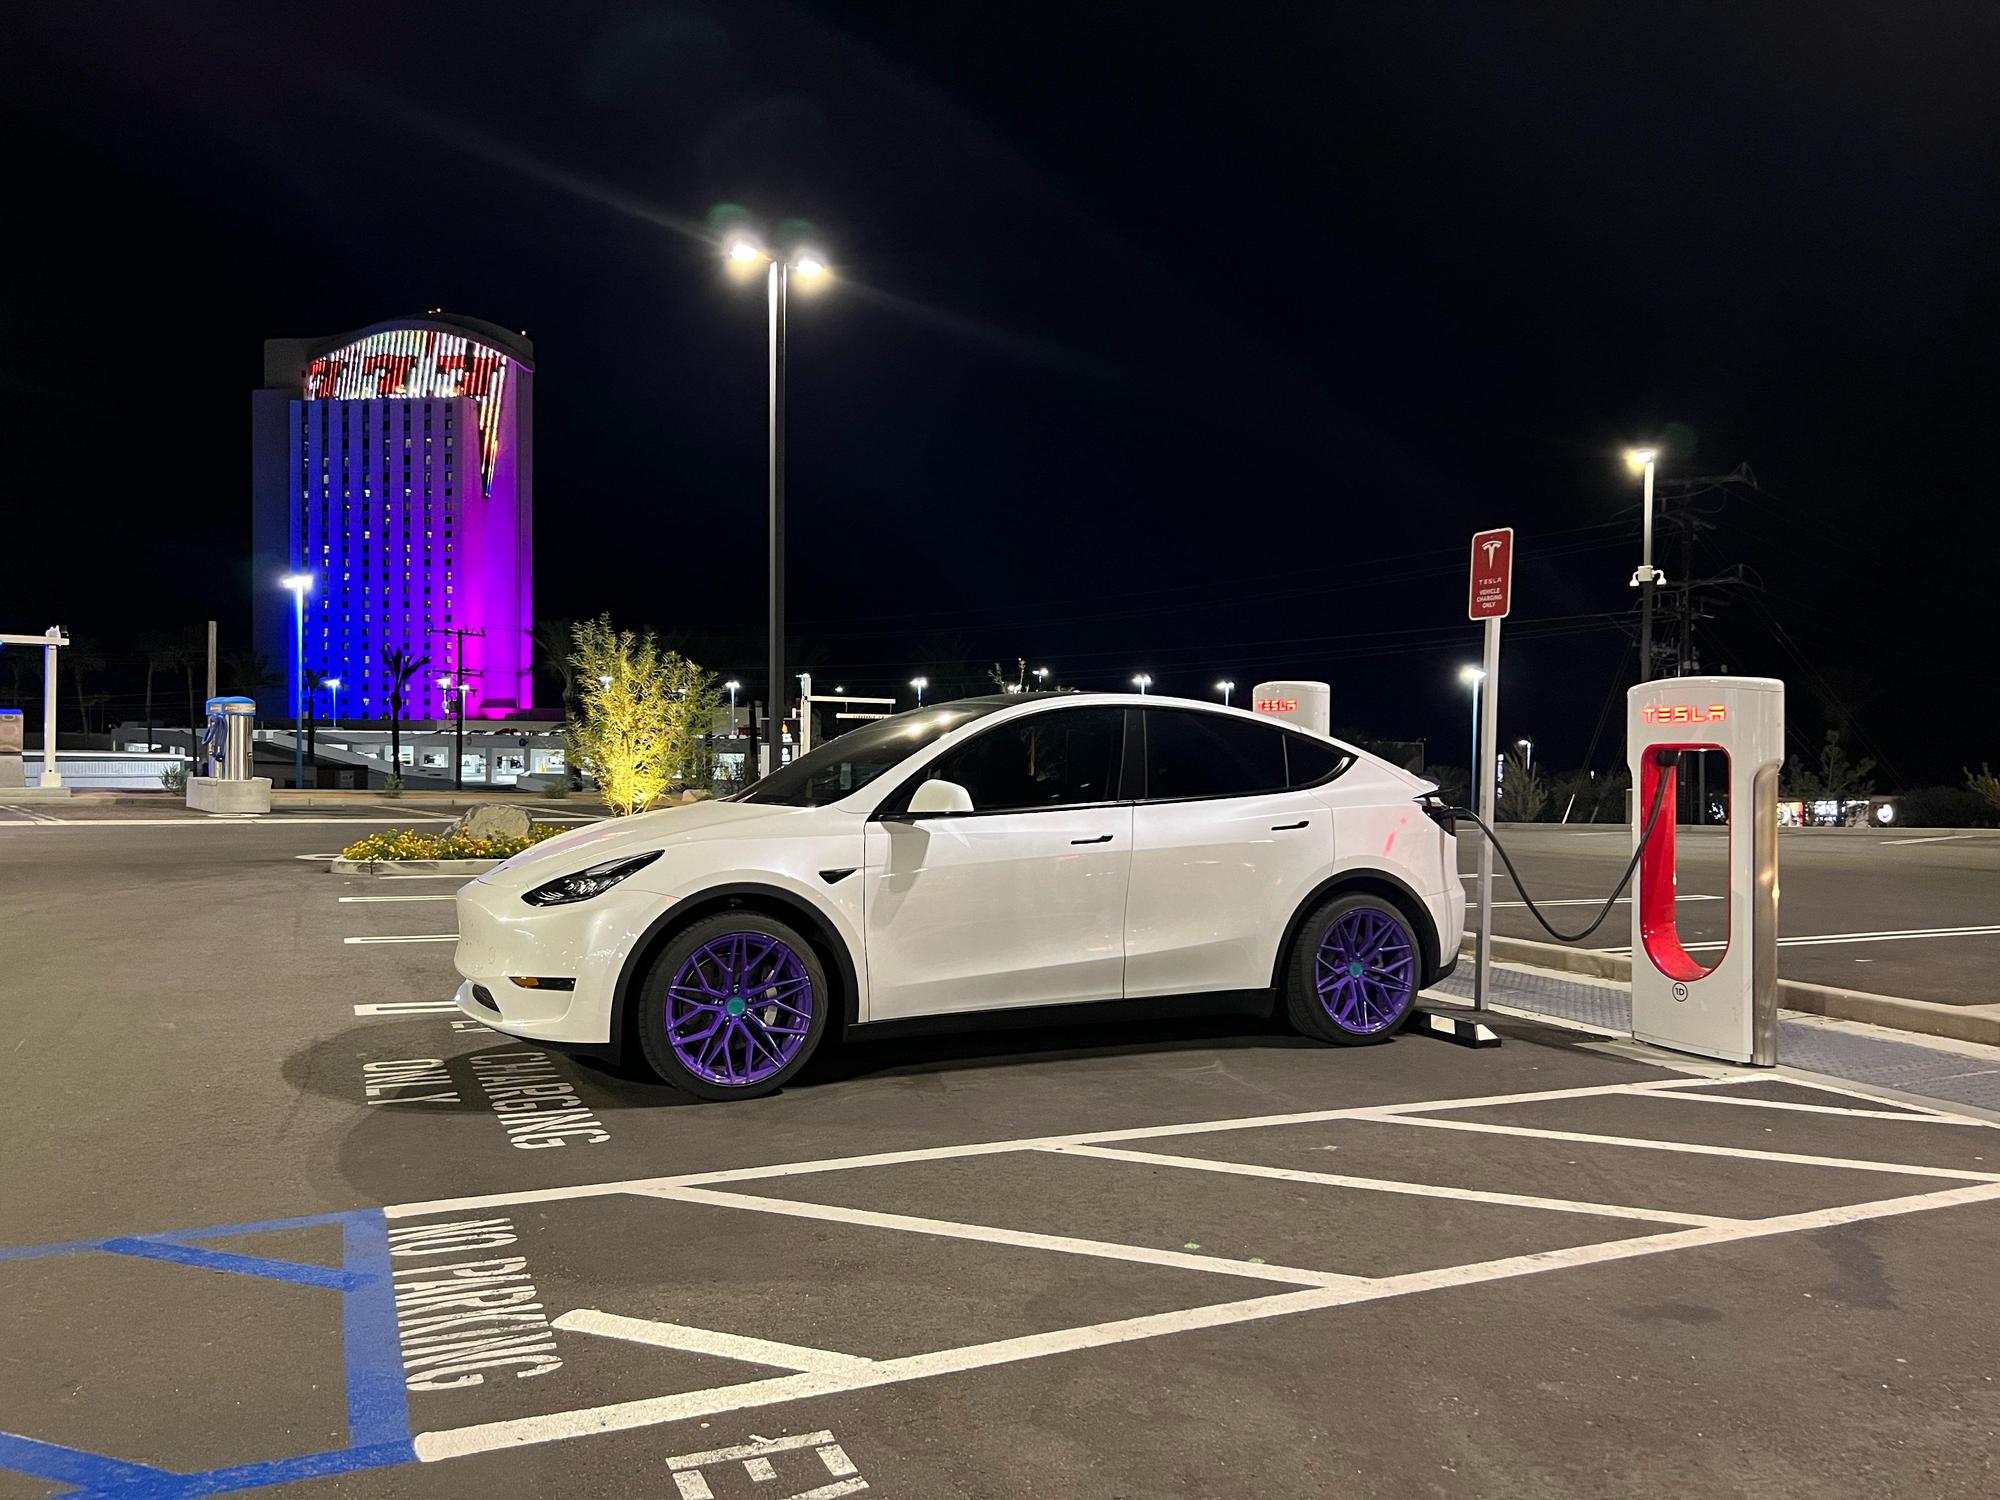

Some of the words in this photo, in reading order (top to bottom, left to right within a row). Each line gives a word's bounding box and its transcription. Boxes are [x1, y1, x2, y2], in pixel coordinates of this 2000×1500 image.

[1479, 577, 1502, 586] TESLA
[1479, 587, 1500, 595] VEHICLE
[1476, 594, 1502, 602] CHARGING
[1257, 699, 1297, 711] TESLA
[1643, 704, 1726, 723] TESLA
[363, 1058, 462, 1105] ONLY
[468, 1052, 612, 1150] CHARGING
[388, 1217, 519, 1256] NO
[391, 1256, 564, 1391] PARKING
